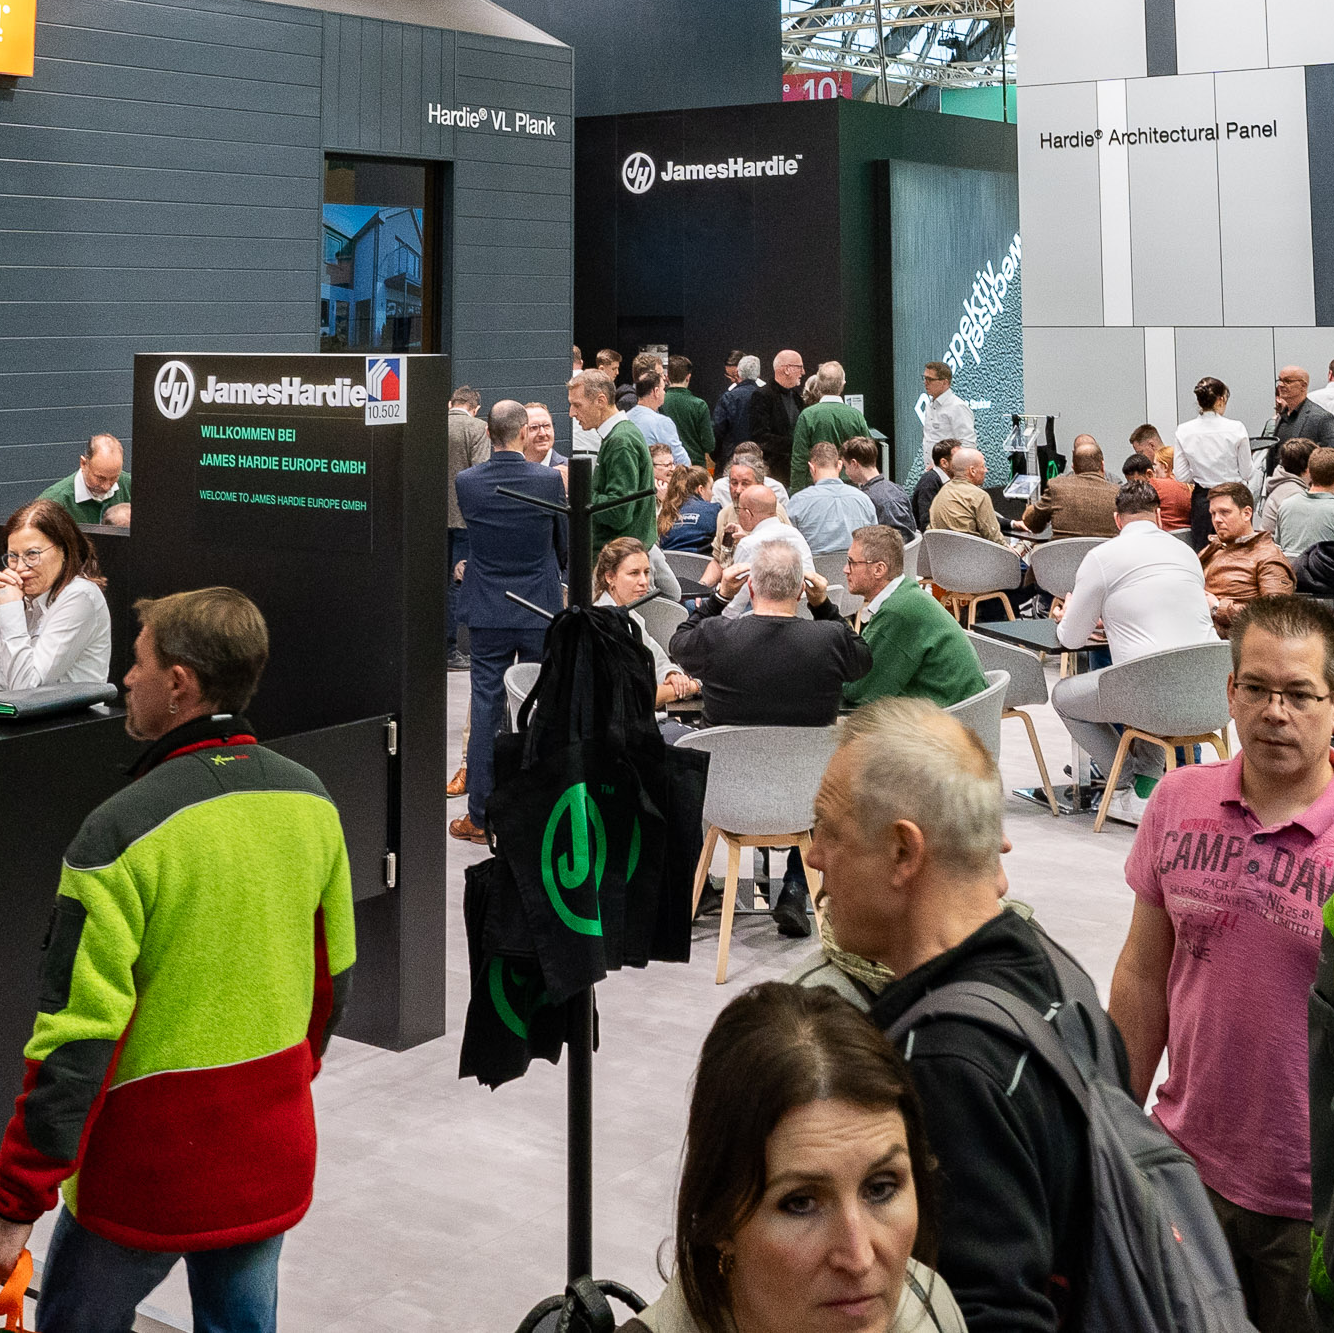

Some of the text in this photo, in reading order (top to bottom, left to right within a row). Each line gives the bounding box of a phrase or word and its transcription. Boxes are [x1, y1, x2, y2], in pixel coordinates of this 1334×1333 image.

[803, 77, 837, 100] 10
[491, 110, 511, 131] VL
[515, 113, 555, 135] Plank
[1109, 122, 1219, 145] Architectural
[1226, 120, 1277, 139] Panel
[200, 376, 366, 407] JamesHardie
[368, 404, 400, 419] 10.502
[200, 425, 296, 442] WILLKOMMEN BEI
[200, 453, 366, 474] JAMES HARDIE EUROPE GMBH
[200, 490, 366, 511] WELCOME TO JAMES HARDIE EUROPE GMBH
[1159, 831, 1245, 874] CAMP
